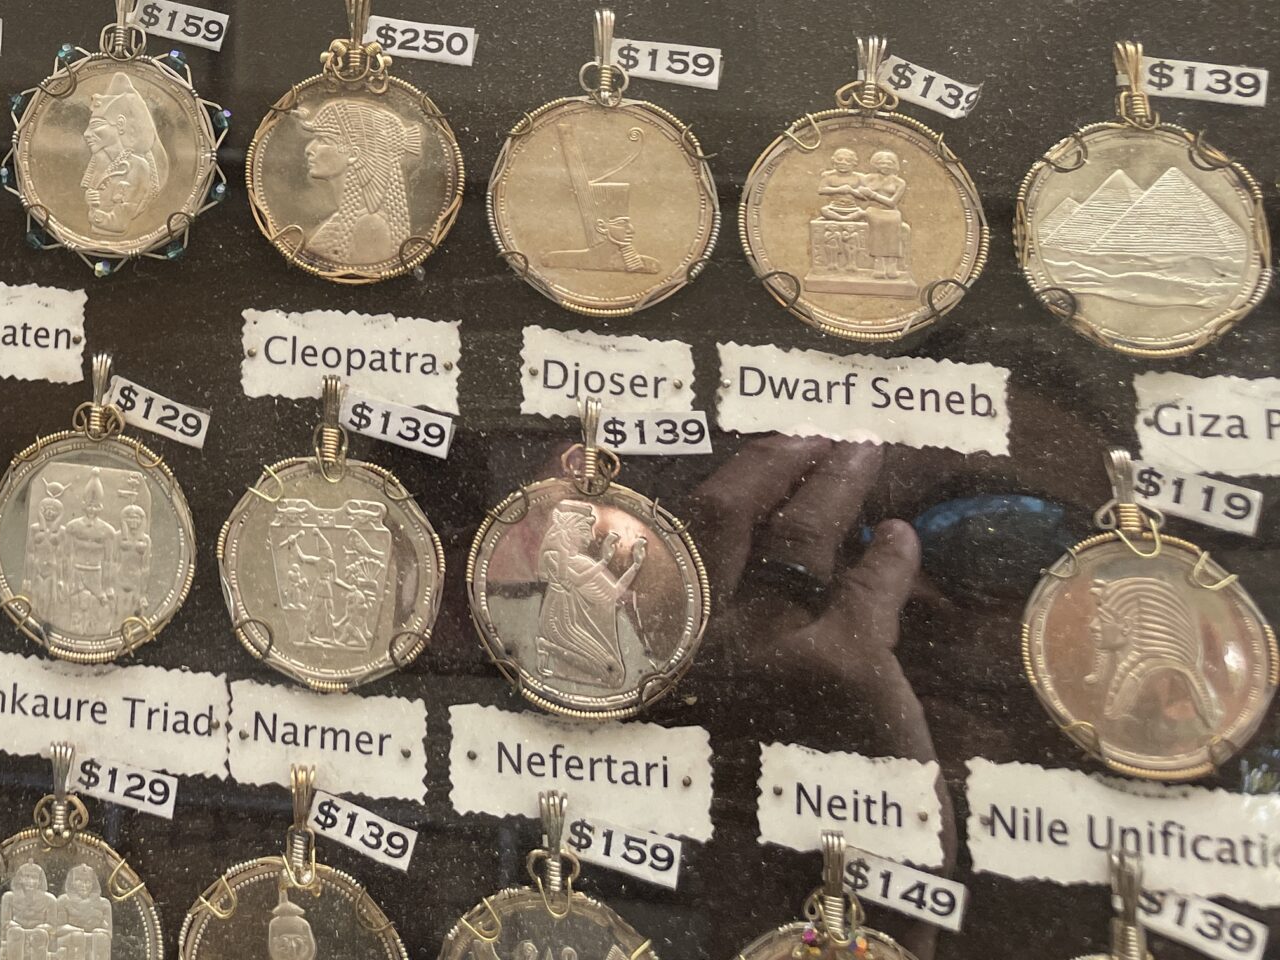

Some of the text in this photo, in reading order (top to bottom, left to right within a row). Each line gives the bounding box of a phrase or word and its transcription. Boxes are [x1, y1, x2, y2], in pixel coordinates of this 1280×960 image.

[138, 2, 224, 42] $159
[376, 23, 469, 56] $250
[616, 43, 715, 77] $159
[1147, 60, 1261, 99] $139
[263, 335, 439, 377] Cleopatra
[542, 359, 667, 399] Djoser
[115, 385, 203, 438] $129
[739, 366, 994, 417] Dwarf Seneb
[349, 401, 447, 448] $139
[603, 416, 706, 448] $139
[1153, 403, 1248, 440] Giza
[1135, 466, 1253, 521] $119
[121, 696, 214, 738] Triad
[253, 711, 392, 757] Narmer
[77, 758, 171, 806] $129
[497, 741, 670, 788] Nefertari
[795, 782, 903, 828] Neith
[990, 804, 1069, 847] Nile
[313, 798, 410, 861] $139
[569, 818, 676, 872] $159
[844, 858, 957, 917] $149
[1137, 890, 1257, 953] $139
